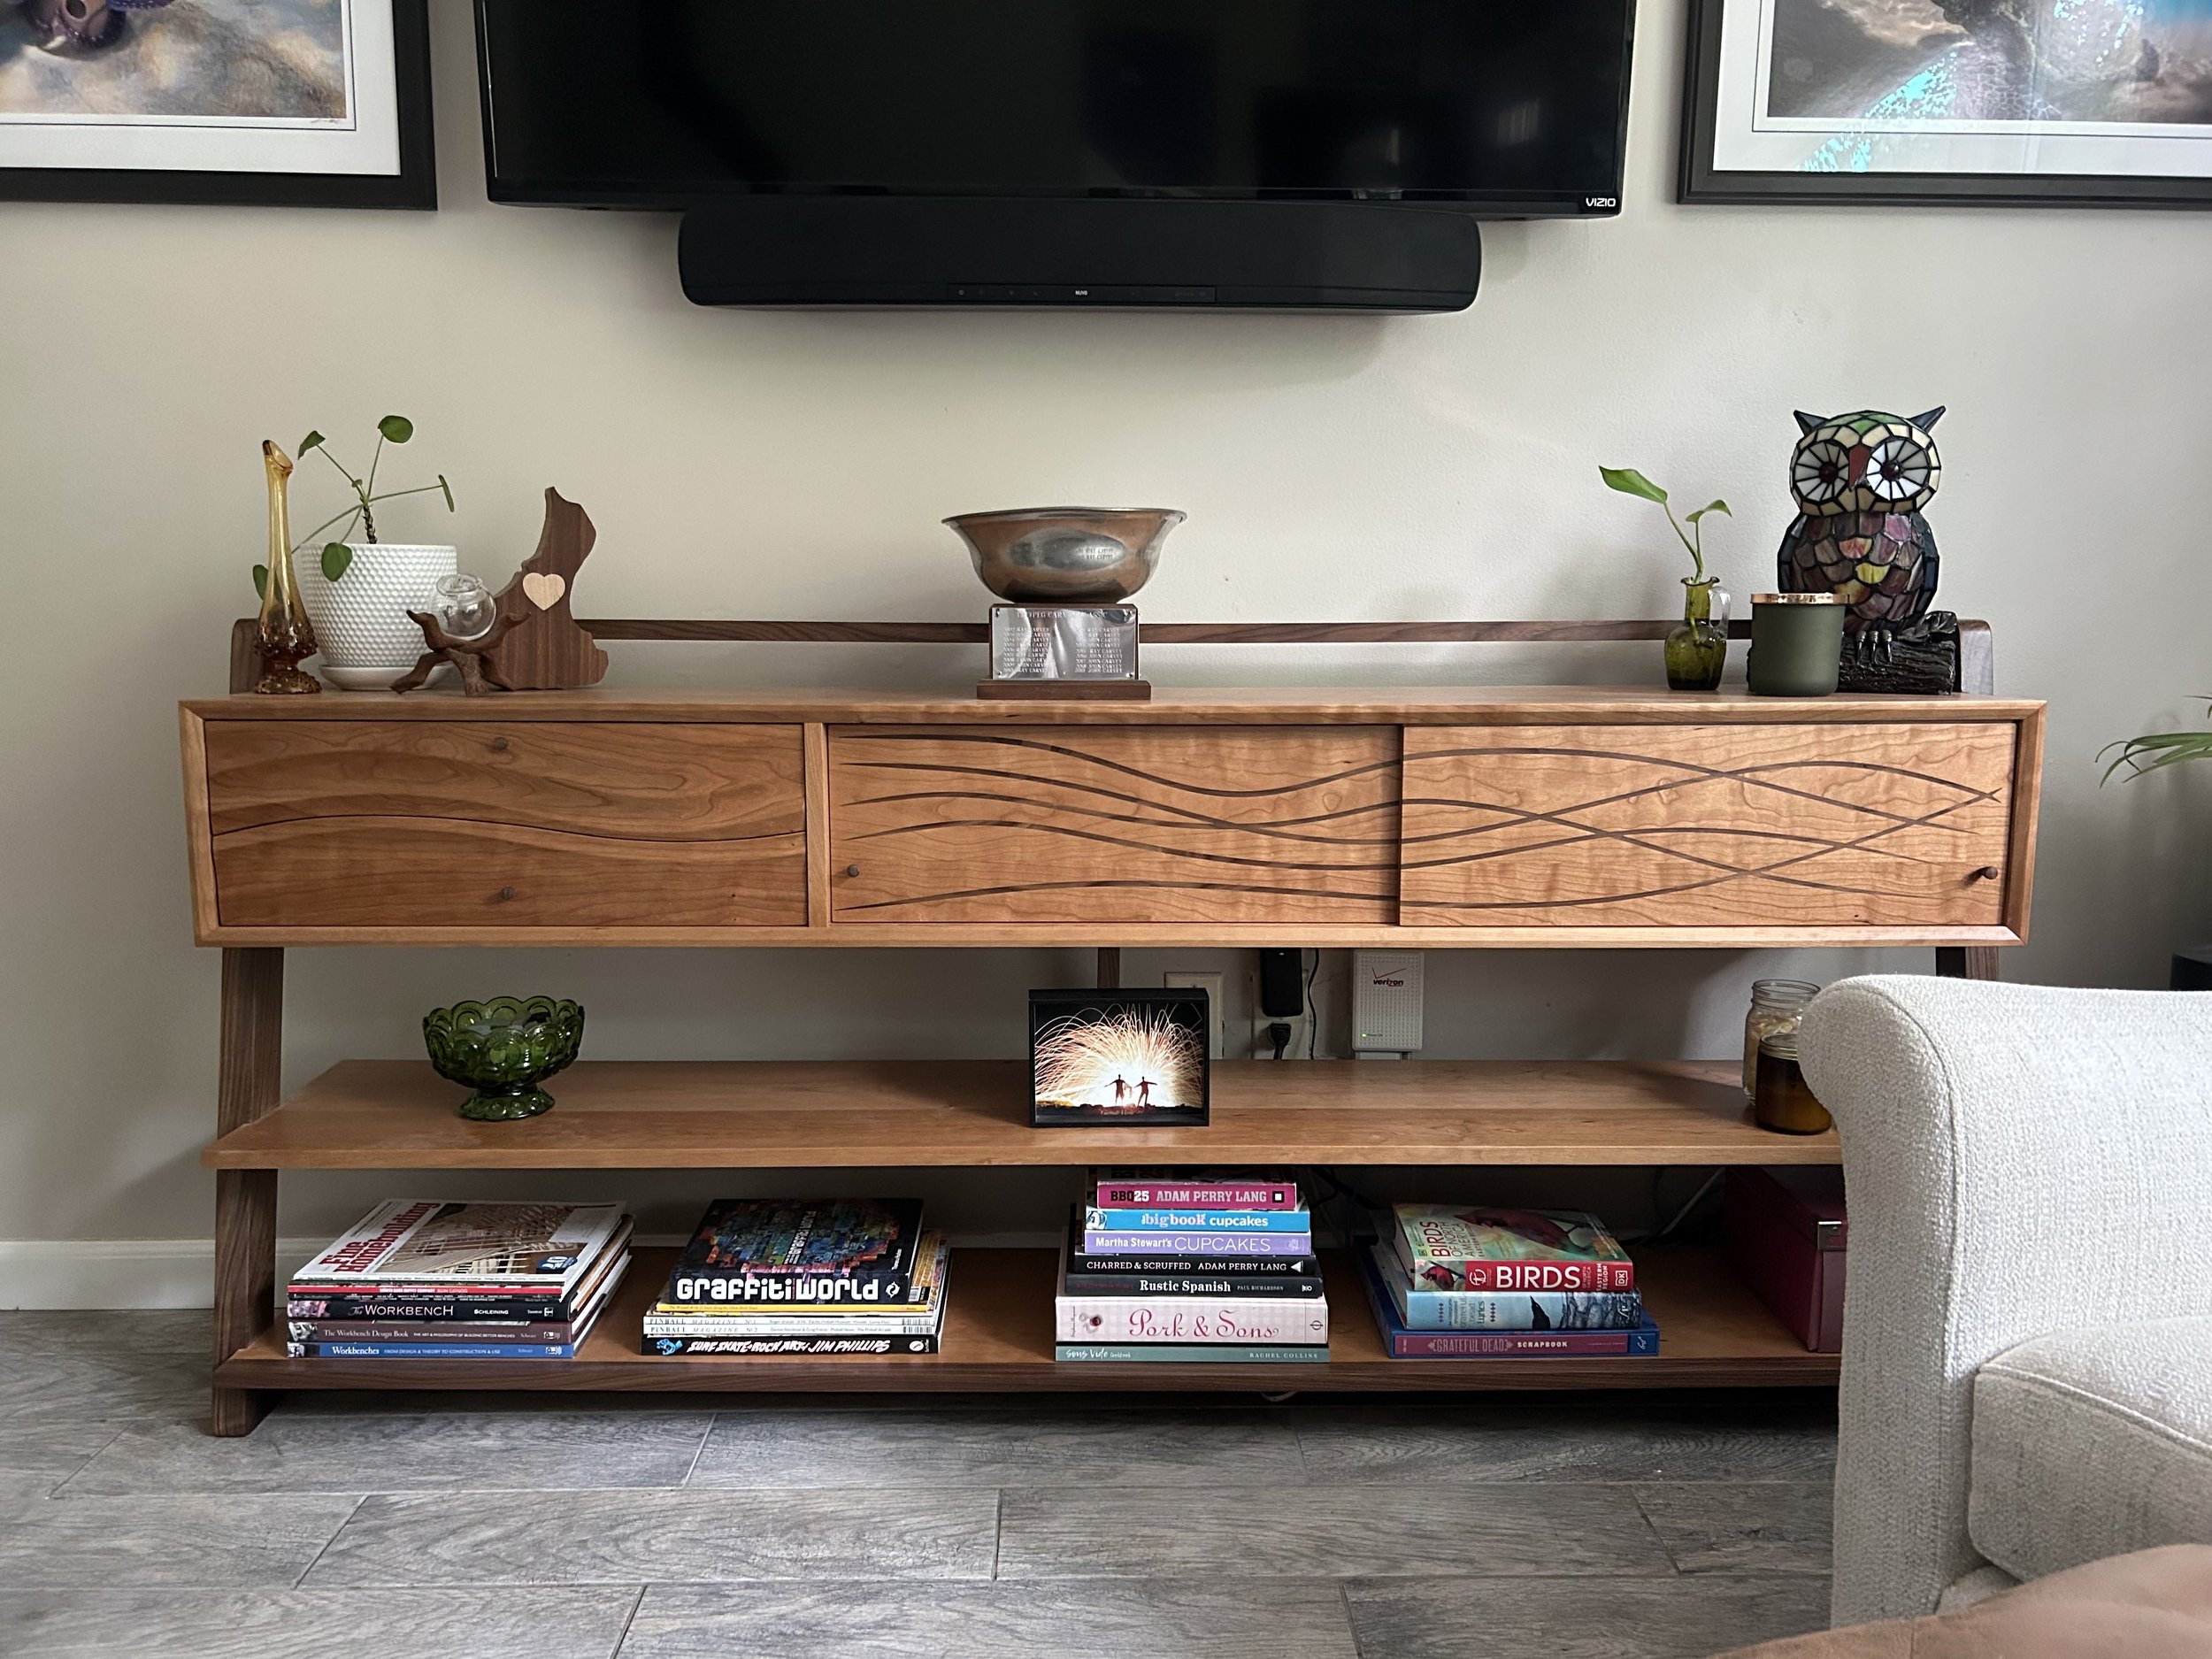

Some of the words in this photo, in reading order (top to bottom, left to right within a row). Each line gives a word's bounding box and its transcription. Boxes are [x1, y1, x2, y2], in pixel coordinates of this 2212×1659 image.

[1586, 197, 1617, 207] VIZIO
[1156, 1190, 1190, 1202] ADAM
[1193, 1191, 1233, 1202] PERRY
[1235, 1191, 1267, 1202] LANG
[1145, 1213, 1171, 1228] big
[1170, 1213, 1206, 1225] book
[1209, 1216, 1269, 1227] cupcakes
[333, 1202, 441, 1272] Homebuilding
[1419, 1222, 1451, 1256] BIRDS
[1439, 1222, 1458, 1245] NORTH
[1452, 1223, 1476, 1256] AMERICA
[1095, 1237, 1128, 1248] Martha
[1131, 1237, 1172, 1248] Stewart's
[1175, 1237, 1271, 1252] CUPCAKES
[1448, 1246, 1463, 1256] OF
[319, 1241, 370, 1265] Fine
[1496, 1265, 1581, 1289] BIRDS
[1618, 1272, 1625, 1284] DK
[1140, 1279, 1179, 1291] Rustic
[1181, 1280, 1232, 1294] Spanish
[365, 1305, 454, 1316] WORKBENCH
[1129, 1308, 1188, 1338] Pork
[1193, 1315, 1210, 1338] &
[1216, 1310, 1279, 1338] Sons
[372, 1330, 392, 1339] Design
[332, 1346, 380, 1355] Workbenches
[687, 1340, 718, 1353] SURF
[715, 1340, 752, 1353] SKATE
[750, 1340, 784, 1353] ROCK
[807, 1340, 837, 1352] JIM
[833, 1340, 891, 1353] PHILLIPS
[1437, 1339, 1480, 1352] GRATEFUL
[1482, 1339, 1504, 1351] DEAD
[1065, 1348, 1088, 1359] Sous
